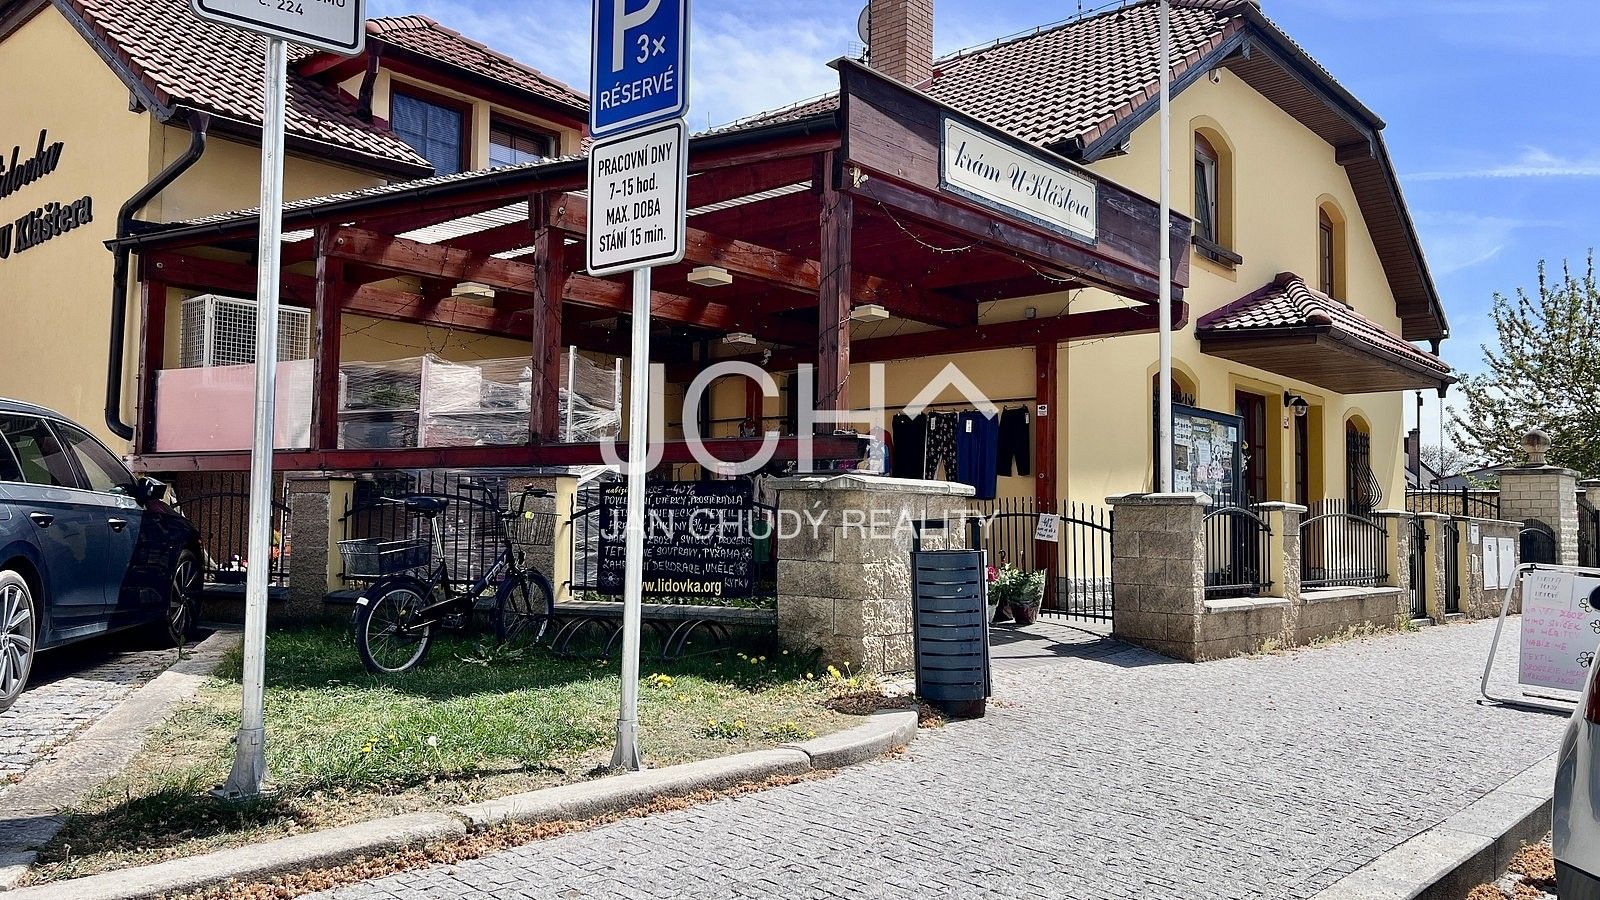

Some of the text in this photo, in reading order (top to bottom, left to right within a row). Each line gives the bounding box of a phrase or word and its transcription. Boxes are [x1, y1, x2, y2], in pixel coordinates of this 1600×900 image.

[277, 0, 304, 16] 224
[612, 0, 661, 73] P
[600, 64, 674, 111] RÉSERVÉ
[598, 142, 673, 178] PRACOVNÍ DNY
[636, 172, 659, 194] hod.
[954, 141, 1001, 183] krám
[1007, 162, 1027, 193] U
[1026, 172, 1090, 218] Kláštera
[13, 195, 94, 254] Kláštera
[606, 197, 661, 226] MAX. DOBA
[599, 224, 667, 253] STÁNÍ 15 min.
